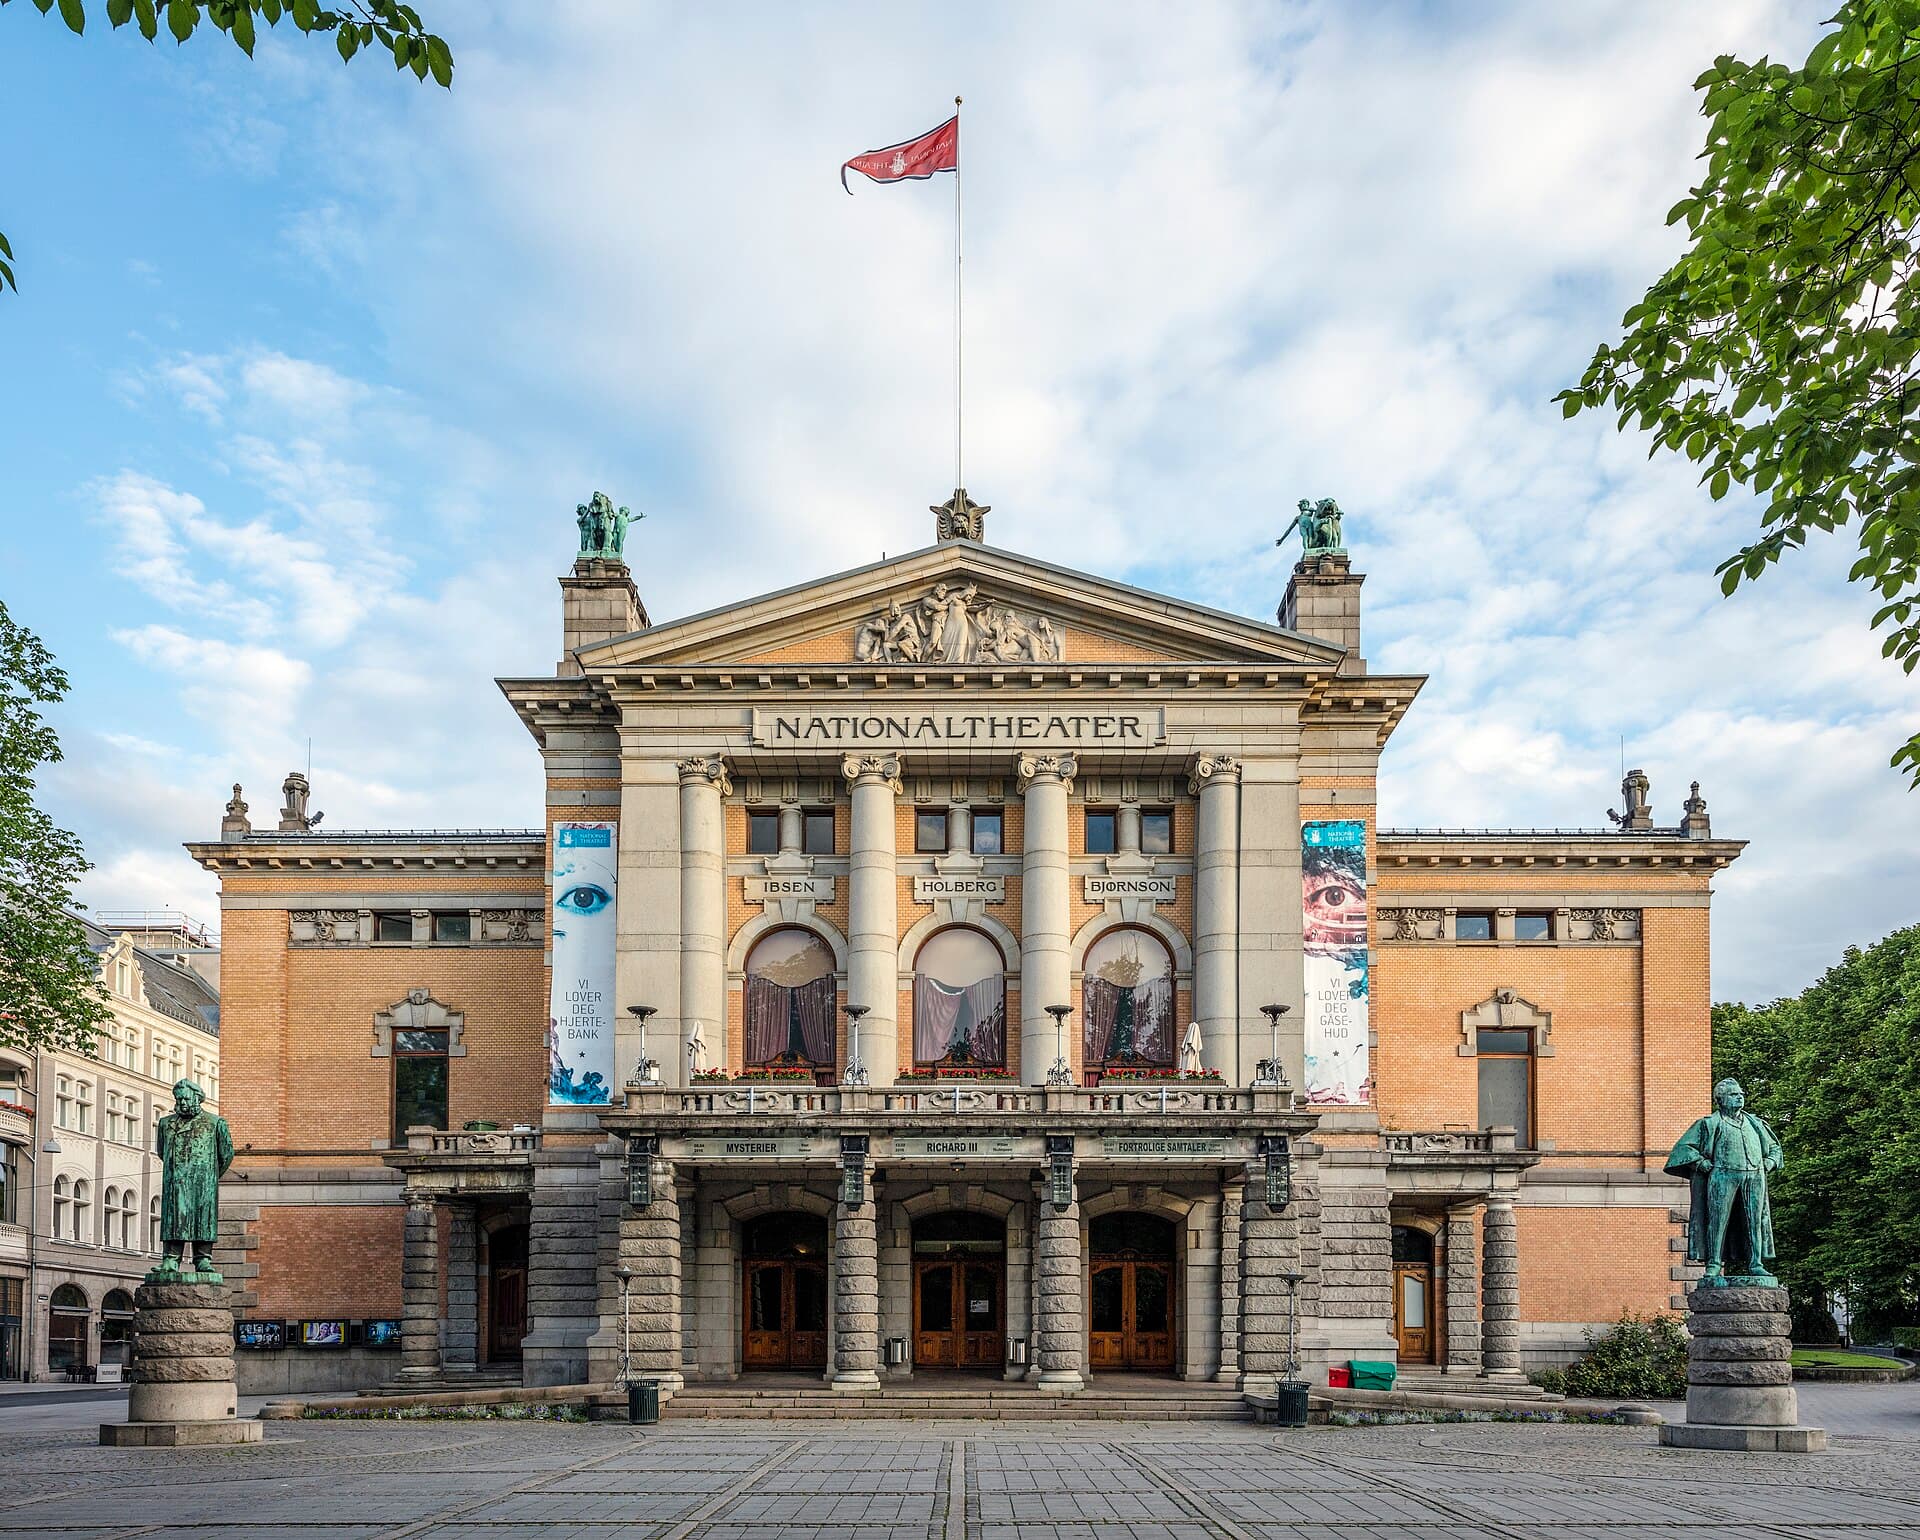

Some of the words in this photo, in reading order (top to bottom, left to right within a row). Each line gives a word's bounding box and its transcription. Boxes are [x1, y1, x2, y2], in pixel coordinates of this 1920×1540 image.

[775, 716, 1143, 739] NATIONALTHEATER
[764, 882, 815, 893] IBSEN
[922, 881, 997, 892] HOLBERG
[1091, 881, 1170, 893] BJØRNSON
[578, 979, 589, 990] VI
[1330, 978, 1341, 988] VI
[565, 991, 602, 1002] LOVER
[572, 1003, 595, 1015] DEG
[1324, 1002, 1348, 1014] DEG
[560, 1016, 606, 1027] HJERTE-
[567, 1028, 599, 1040] BANK
[1324, 1027, 1349, 1039] HUD
[726, 1143, 777, 1153] MYSTERIER
[926, 1142, 967, 1152] RICHARD
[968, 1142, 979, 1152] III
[1118, 1142, 1166, 1152] FORTROLIGE
[1167, 1142, 1207, 1152] SAMTALER
